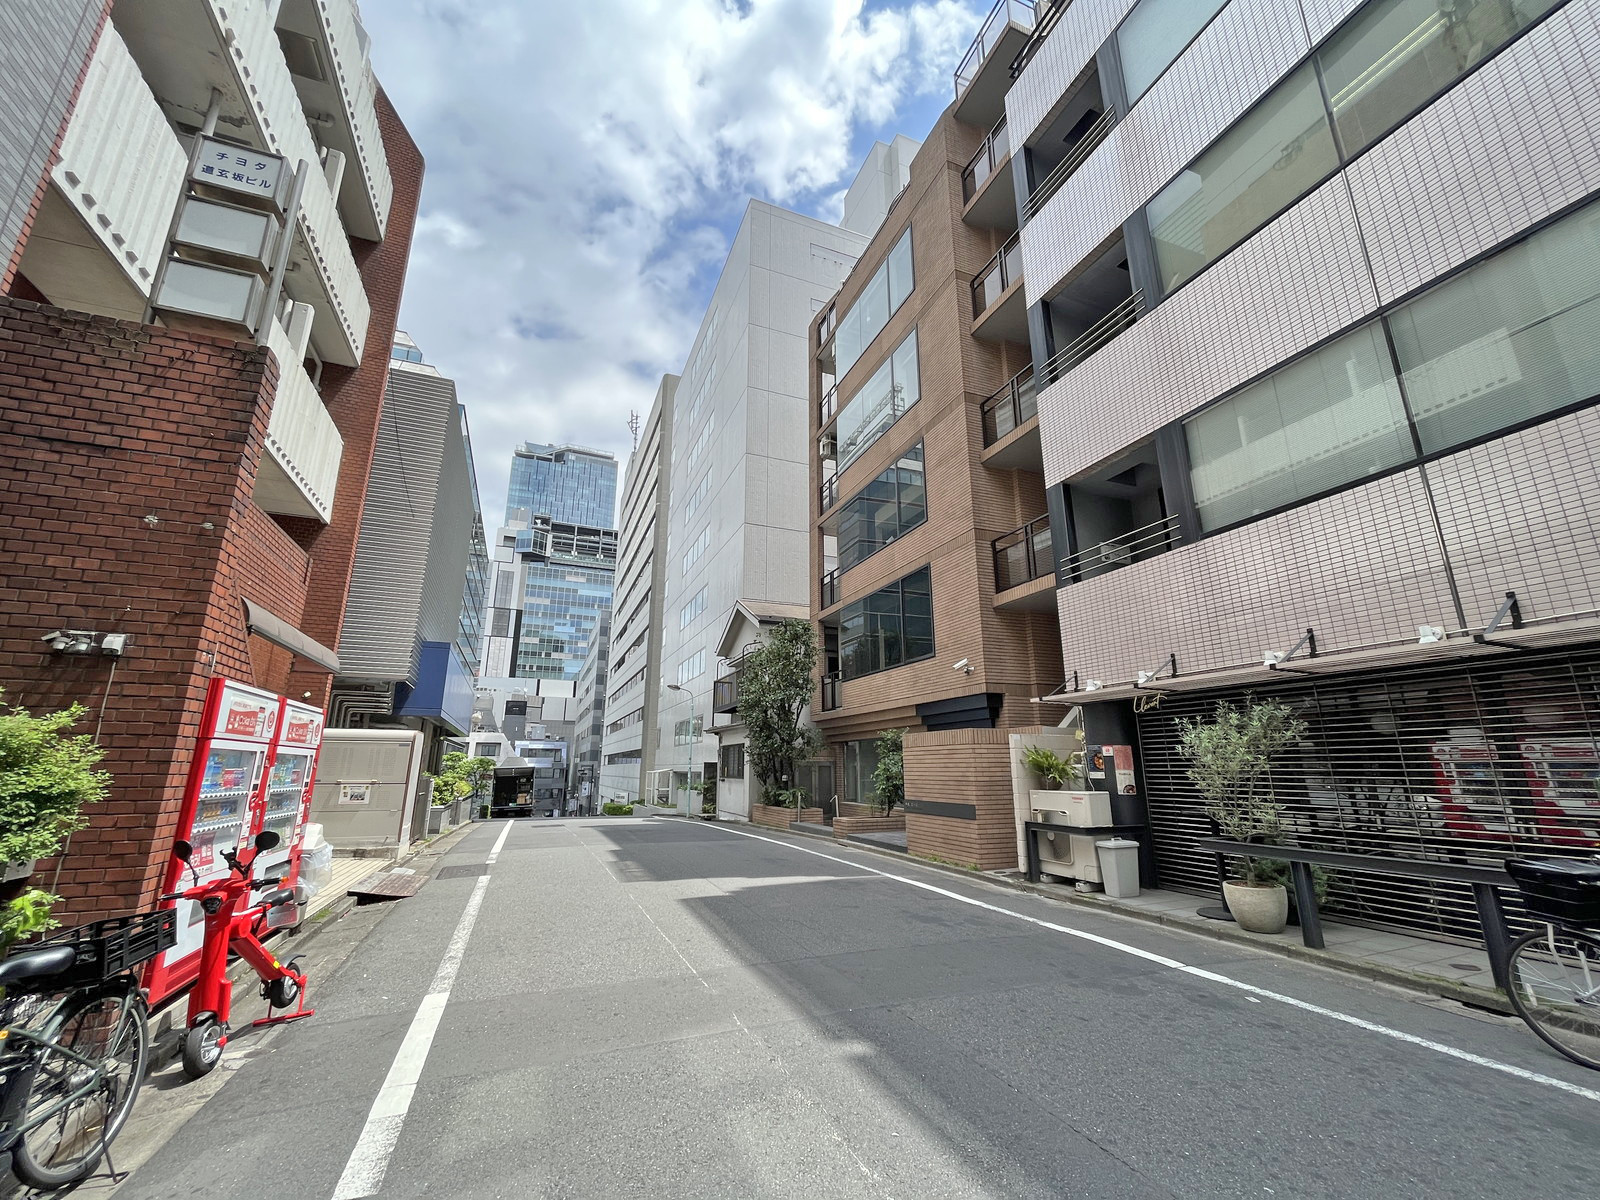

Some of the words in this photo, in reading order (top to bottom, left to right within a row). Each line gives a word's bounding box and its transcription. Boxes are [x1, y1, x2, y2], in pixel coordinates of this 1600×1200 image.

[201, 164, 272, 189] 道玄坂ビル
